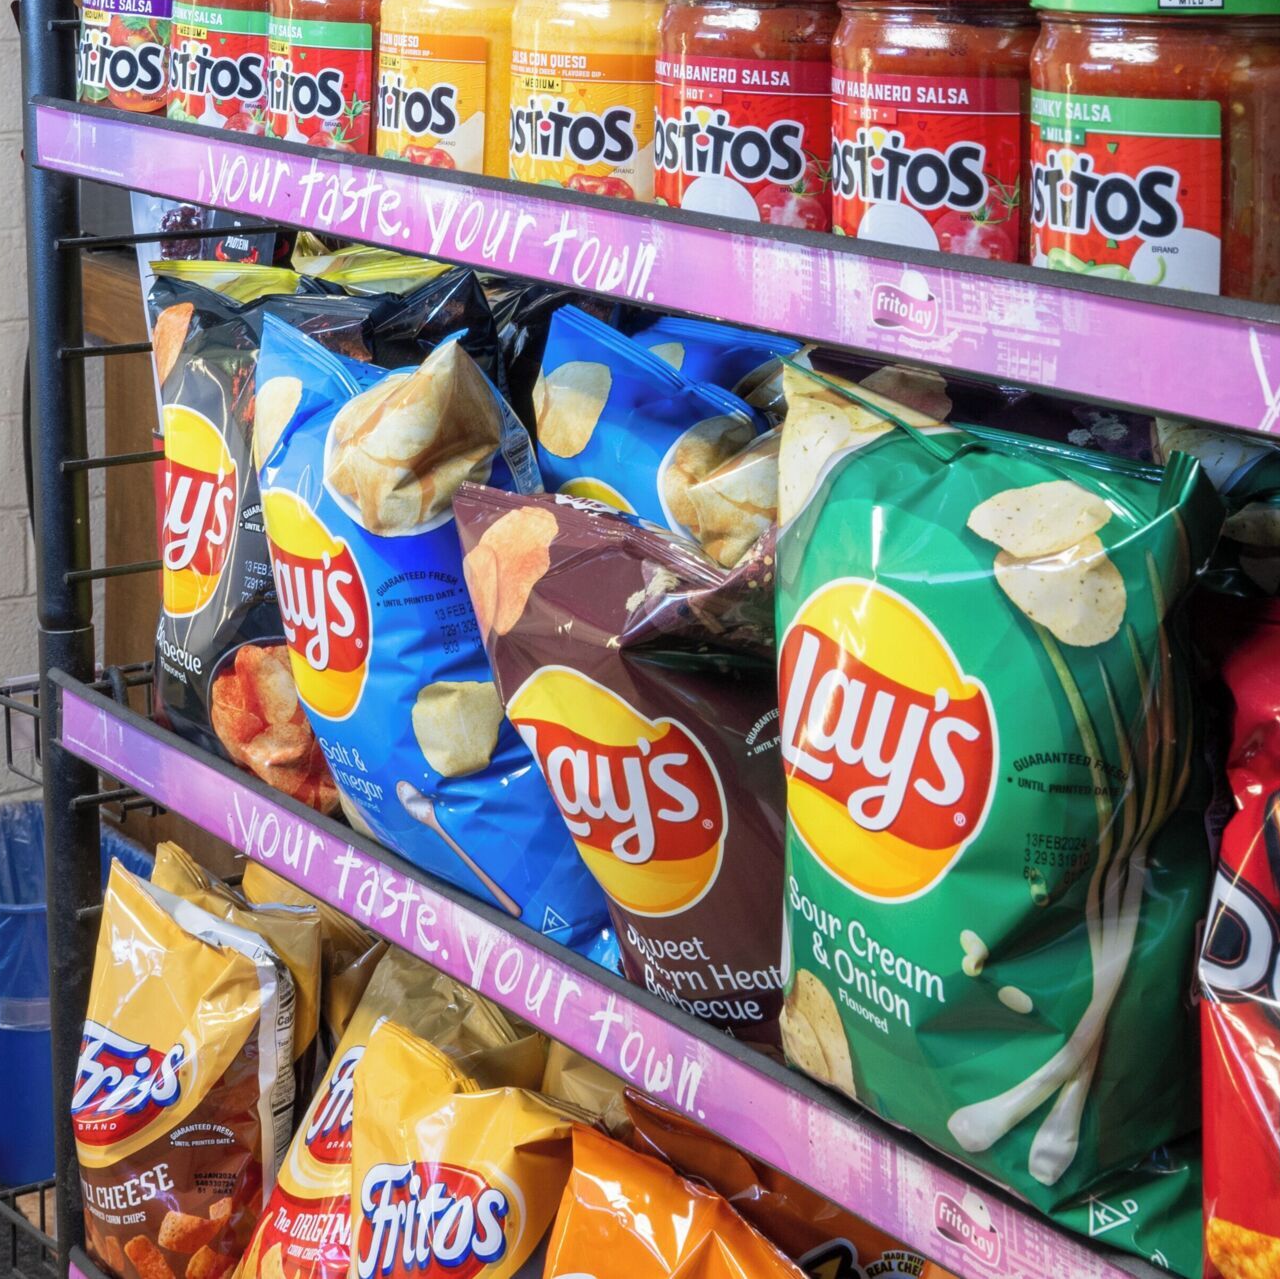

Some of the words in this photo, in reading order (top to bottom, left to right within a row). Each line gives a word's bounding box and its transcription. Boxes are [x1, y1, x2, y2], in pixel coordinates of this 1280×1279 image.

[194, 10, 223, 26] SALSA
[550, 54, 587, 69] QUESO
[671, 64, 737, 84] HABANERO
[741, 70, 791, 87] SALSA
[847, 82, 912, 103] HABANERO
[917, 86, 969, 104] SALSA
[1065, 103, 1112, 123] SALSA
[200, 146, 294, 209] your
[297, 155, 410, 240] taste.
[423, 190, 535, 260] your
[543, 224, 656, 302] town.
[1151, 245, 1180, 254] BRAND
[376, 571, 426, 597] GUARANTEED
[782, 629, 981, 832] Lay's
[319, 736, 354, 768] Salt
[1013, 752, 1091, 773] GUARANTEED
[1018, 777, 1046, 793] UNTIL
[1048, 784, 1092, 795] PRINTED
[789, 875, 842, 940] Sour
[848, 920, 946, 1003] Cream
[227, 793, 326, 877] your
[334, 845, 449, 958] taste.
[460, 919, 582, 1019] your
[589, 994, 707, 1119] town.
[812, 931, 832, 971] &
[834, 949, 911, 1028] Onion
[838, 987, 889, 1034] Flavored
[78, 1122, 118, 1131] BRAND
[170, 1124, 211, 1141] GUARANTEED
[212, 1124, 235, 1138] FRESH
[97, 1163, 176, 1210] CHEESE
[122, 1212, 147, 1225] CHIPS
[356, 1160, 508, 1279] Fritos
